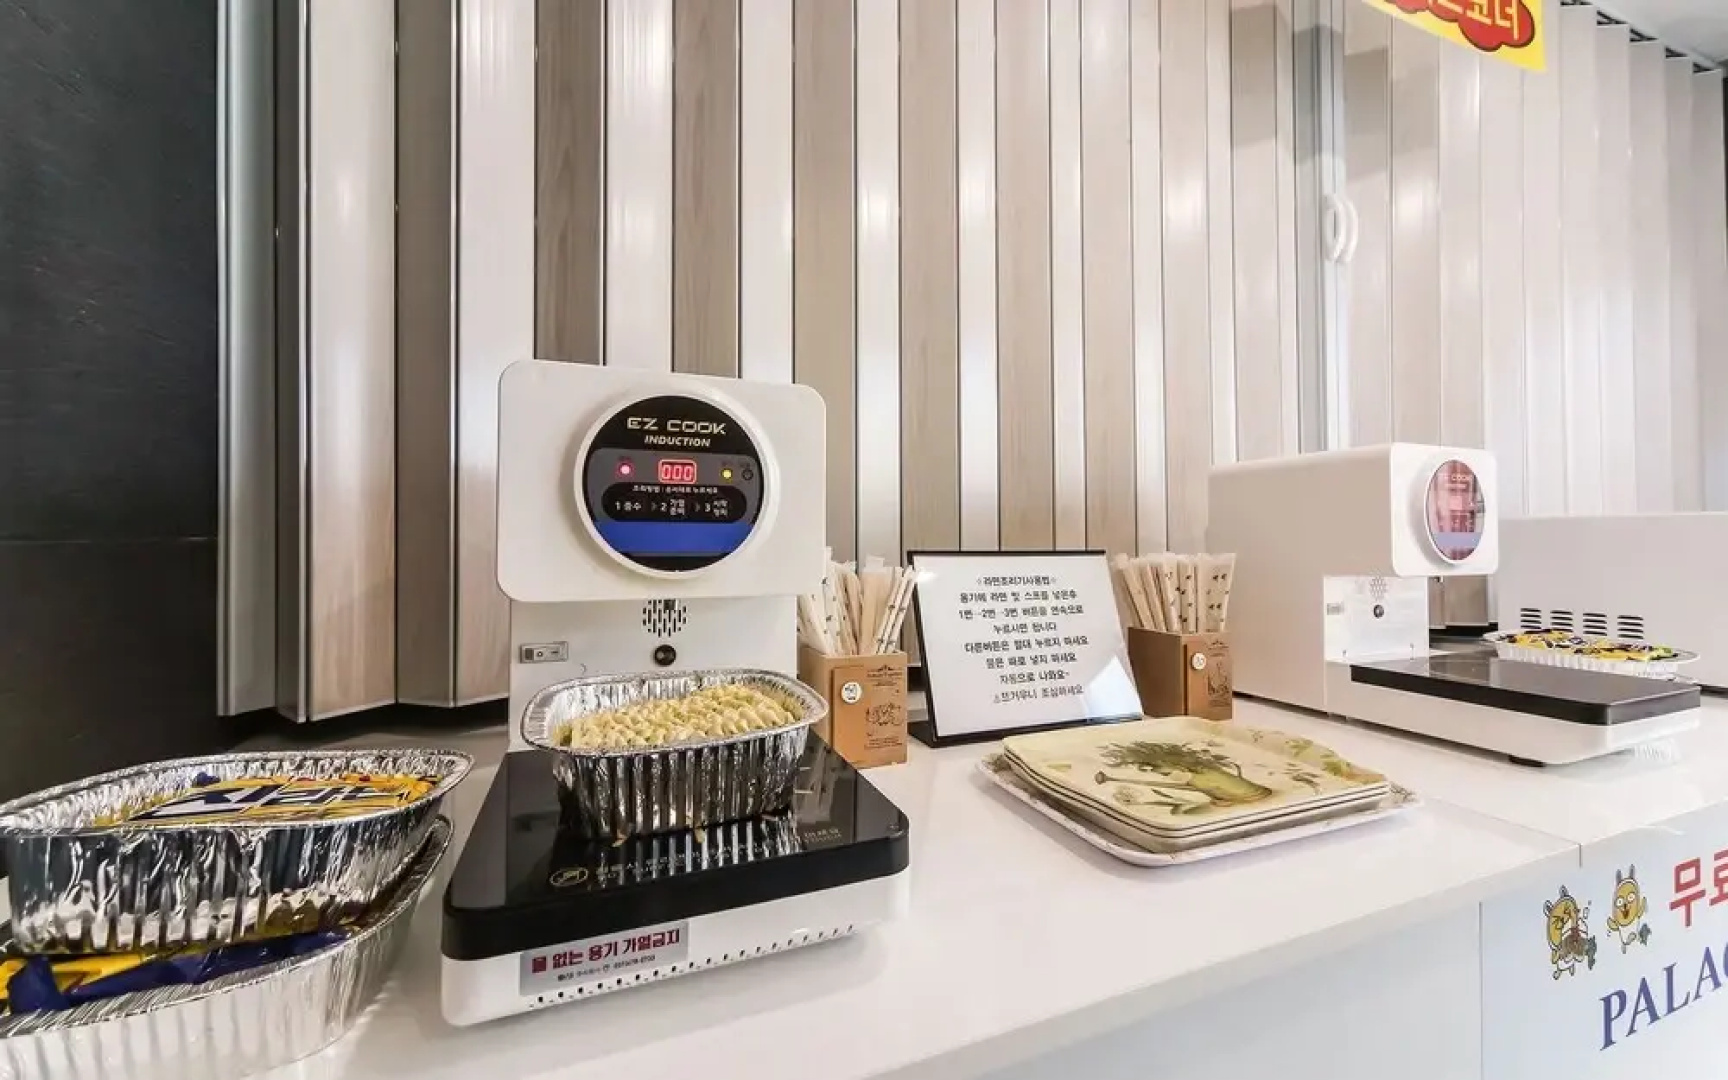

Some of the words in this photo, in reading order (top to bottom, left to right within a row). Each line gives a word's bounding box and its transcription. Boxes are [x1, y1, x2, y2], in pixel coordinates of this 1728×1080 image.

[626, 417, 659, 431] EZ
[666, 419, 727, 435] COOK
[644, 435, 711, 448] INDUCTION
[661, 463, 694, 481] 000
[615, 501, 622, 511] 1
[990, 591, 1008, 602] 라면
[552, 950, 584, 969] 없는
[588, 940, 619, 962] 용기
[622, 927, 681, 955] 가열금지
[1599, 940, 1728, 1052] PALA
